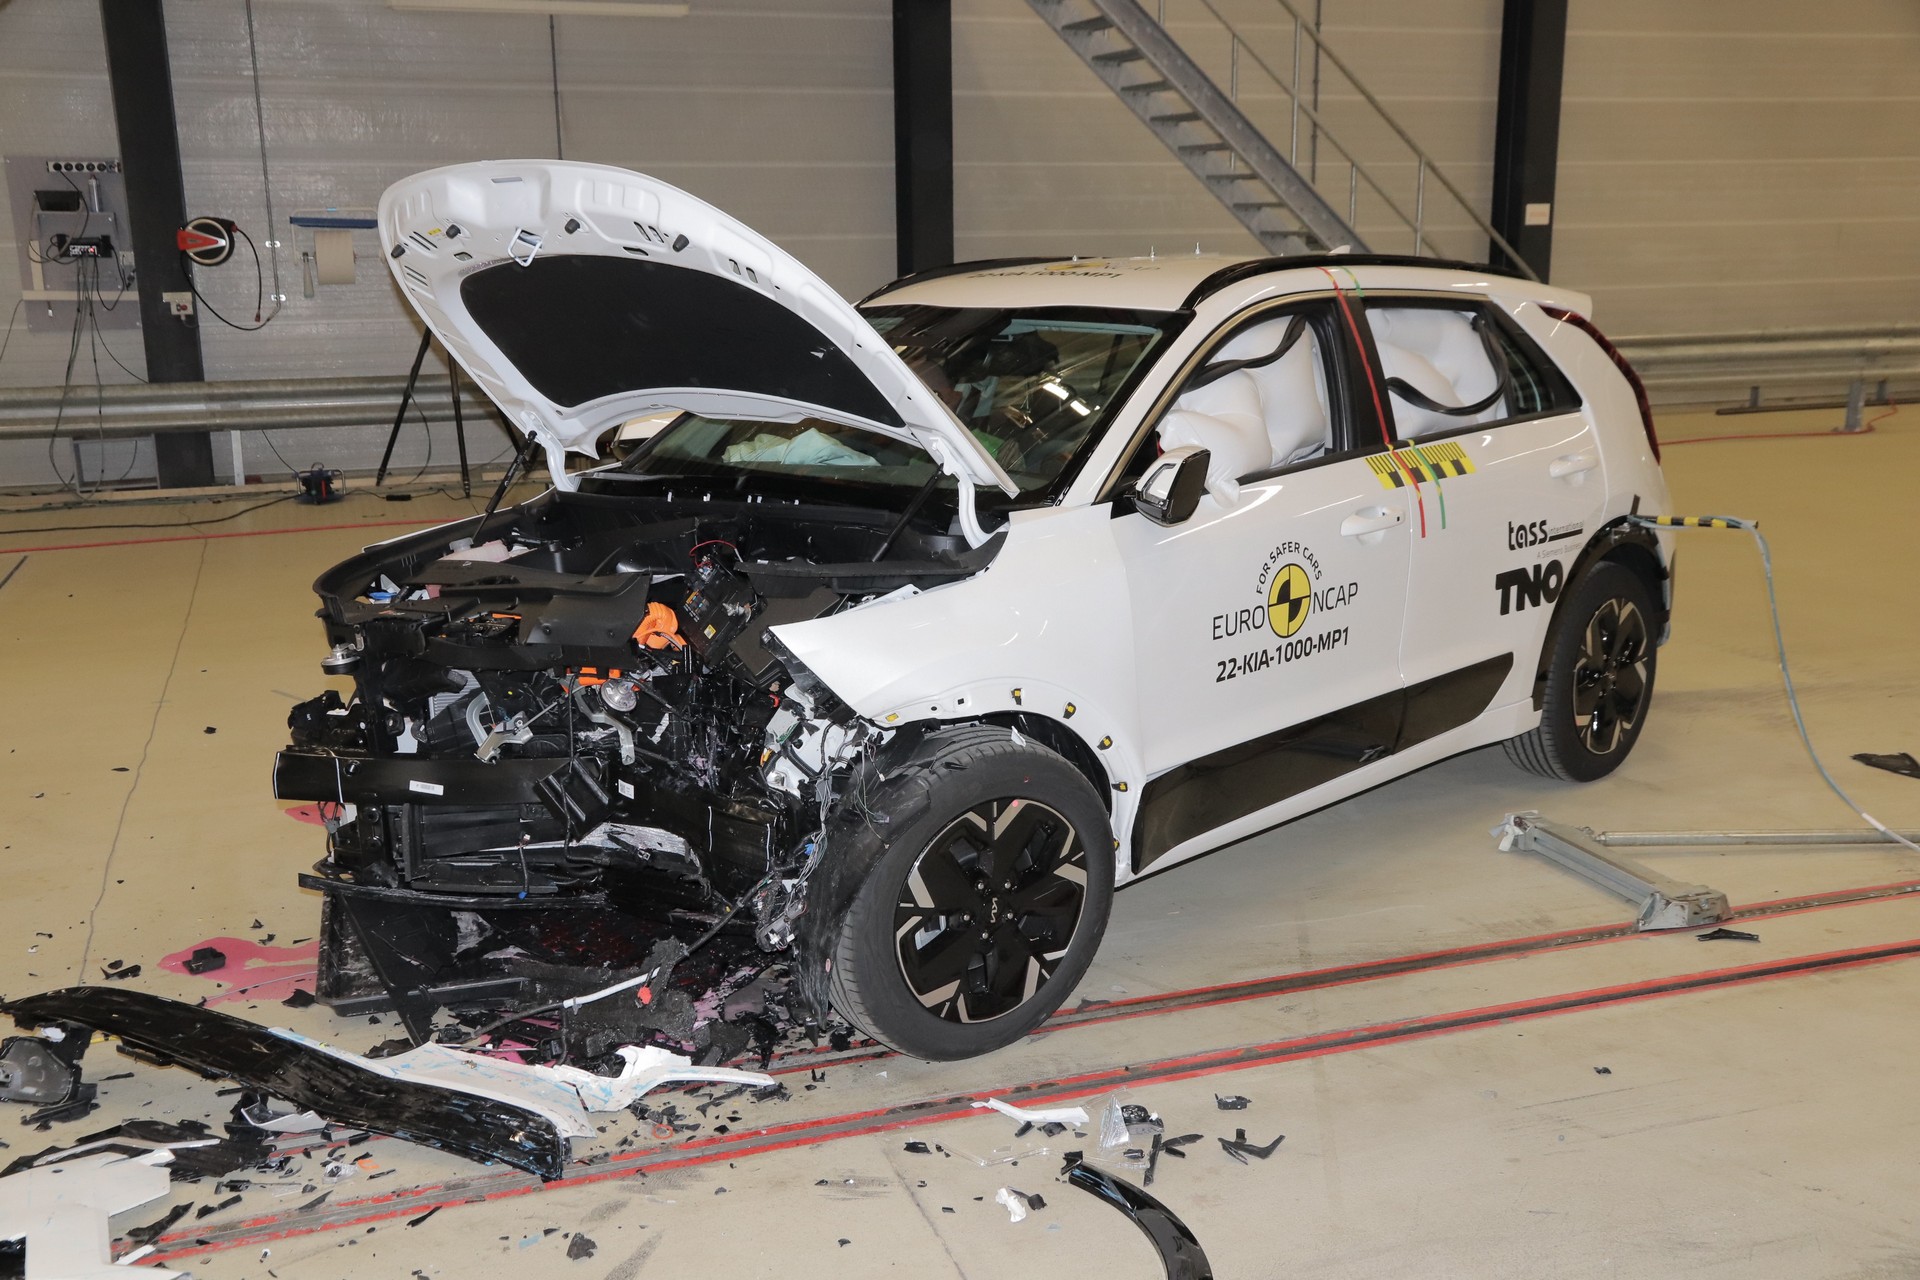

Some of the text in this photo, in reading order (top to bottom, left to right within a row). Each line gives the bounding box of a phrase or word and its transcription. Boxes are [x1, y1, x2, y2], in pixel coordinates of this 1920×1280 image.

[1508, 520, 1548, 551] tass
[1256, 541, 1323, 594] FOR SAFER CARS
[1495, 559, 1564, 616] TNO
[1212, 582, 1359, 641] EURO NCAP
[1215, 626, 1350, 683] 22-KIA-1000-MP1
